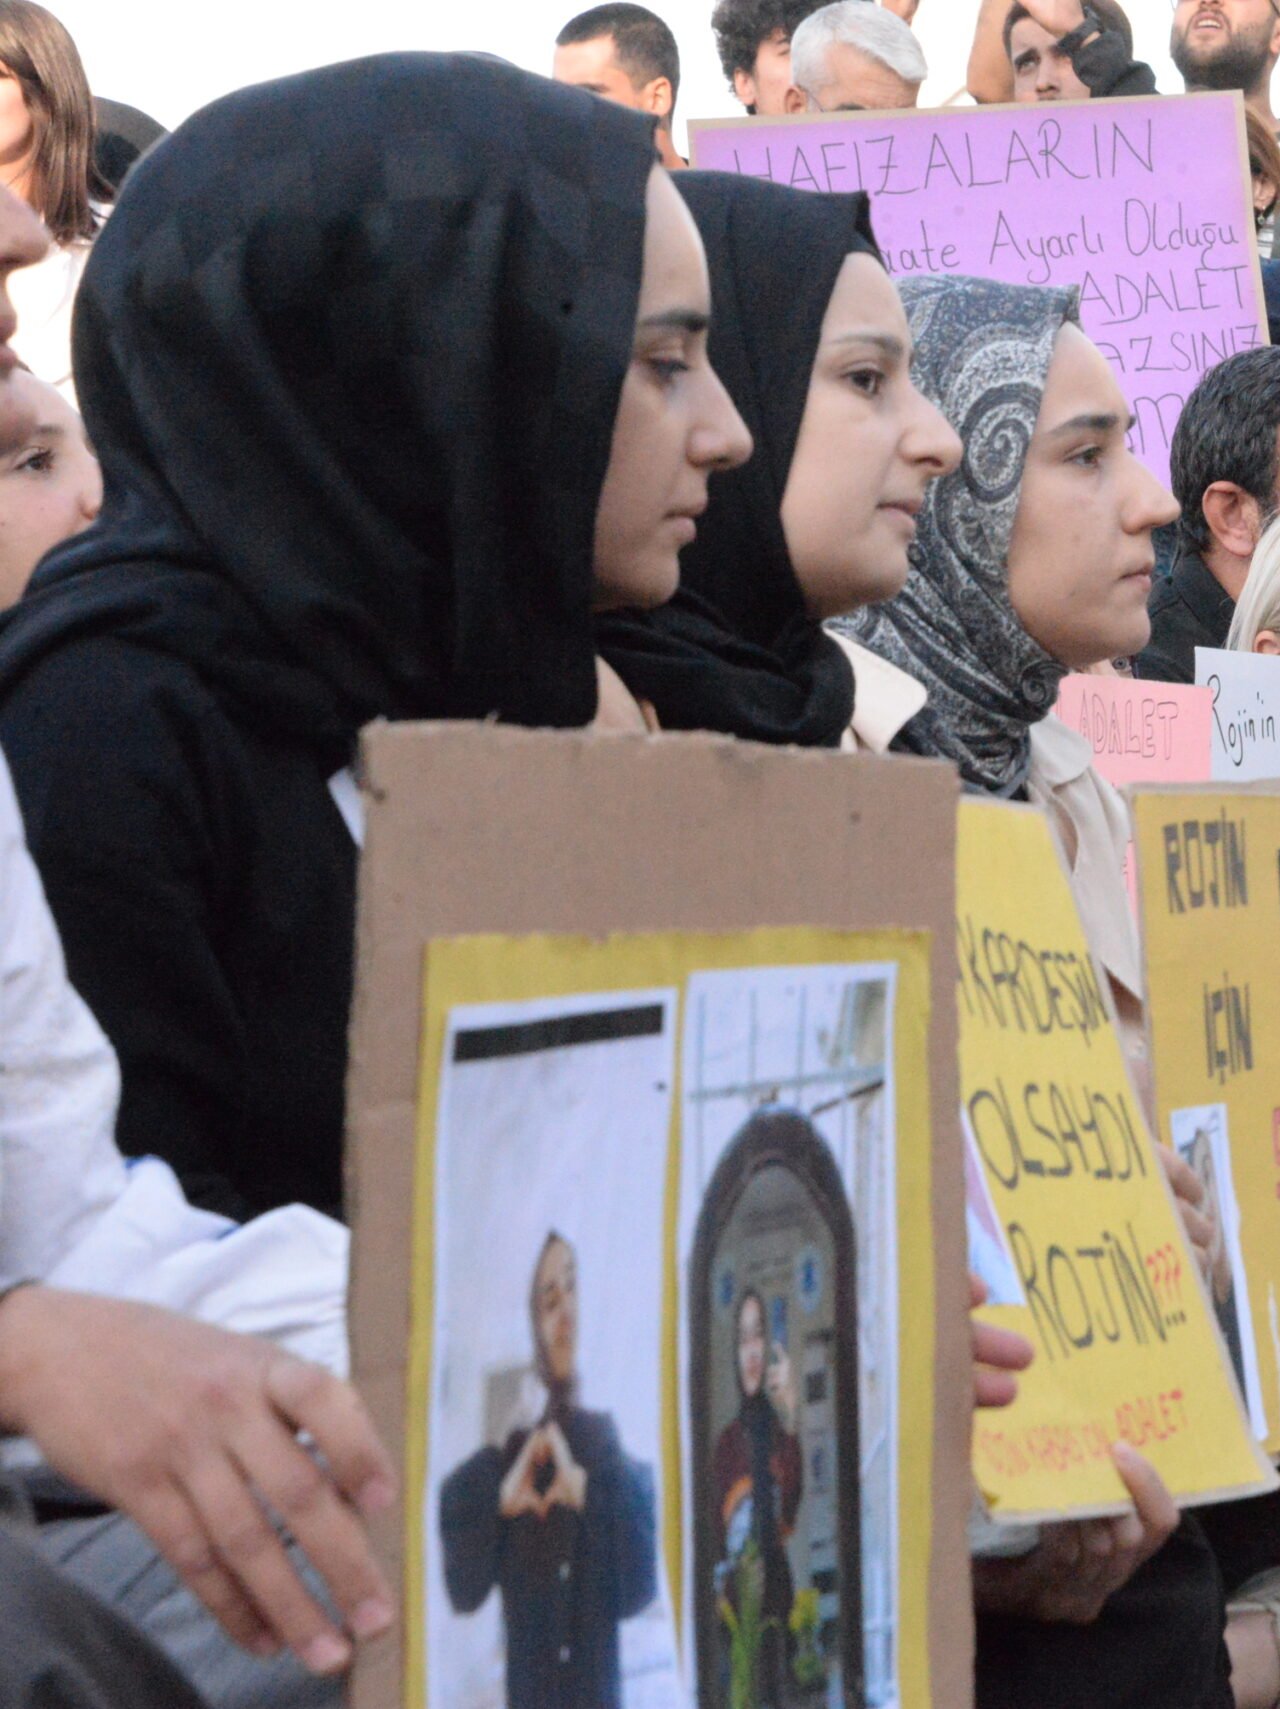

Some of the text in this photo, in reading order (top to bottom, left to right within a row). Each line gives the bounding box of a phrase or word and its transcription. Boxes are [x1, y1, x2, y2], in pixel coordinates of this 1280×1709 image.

[989, 210, 1104, 284] Ayarlı
[1124, 198, 1240, 271] Olduğu
[1080, 265, 1248, 325] ADALET
[1098, 324, 1263, 373] AZSINIZ
[1079, 689, 1178, 760] ADALET
[1162, 805, 1249, 915] ROJİN
[969, 1077, 1147, 1191] OLSAYDI
